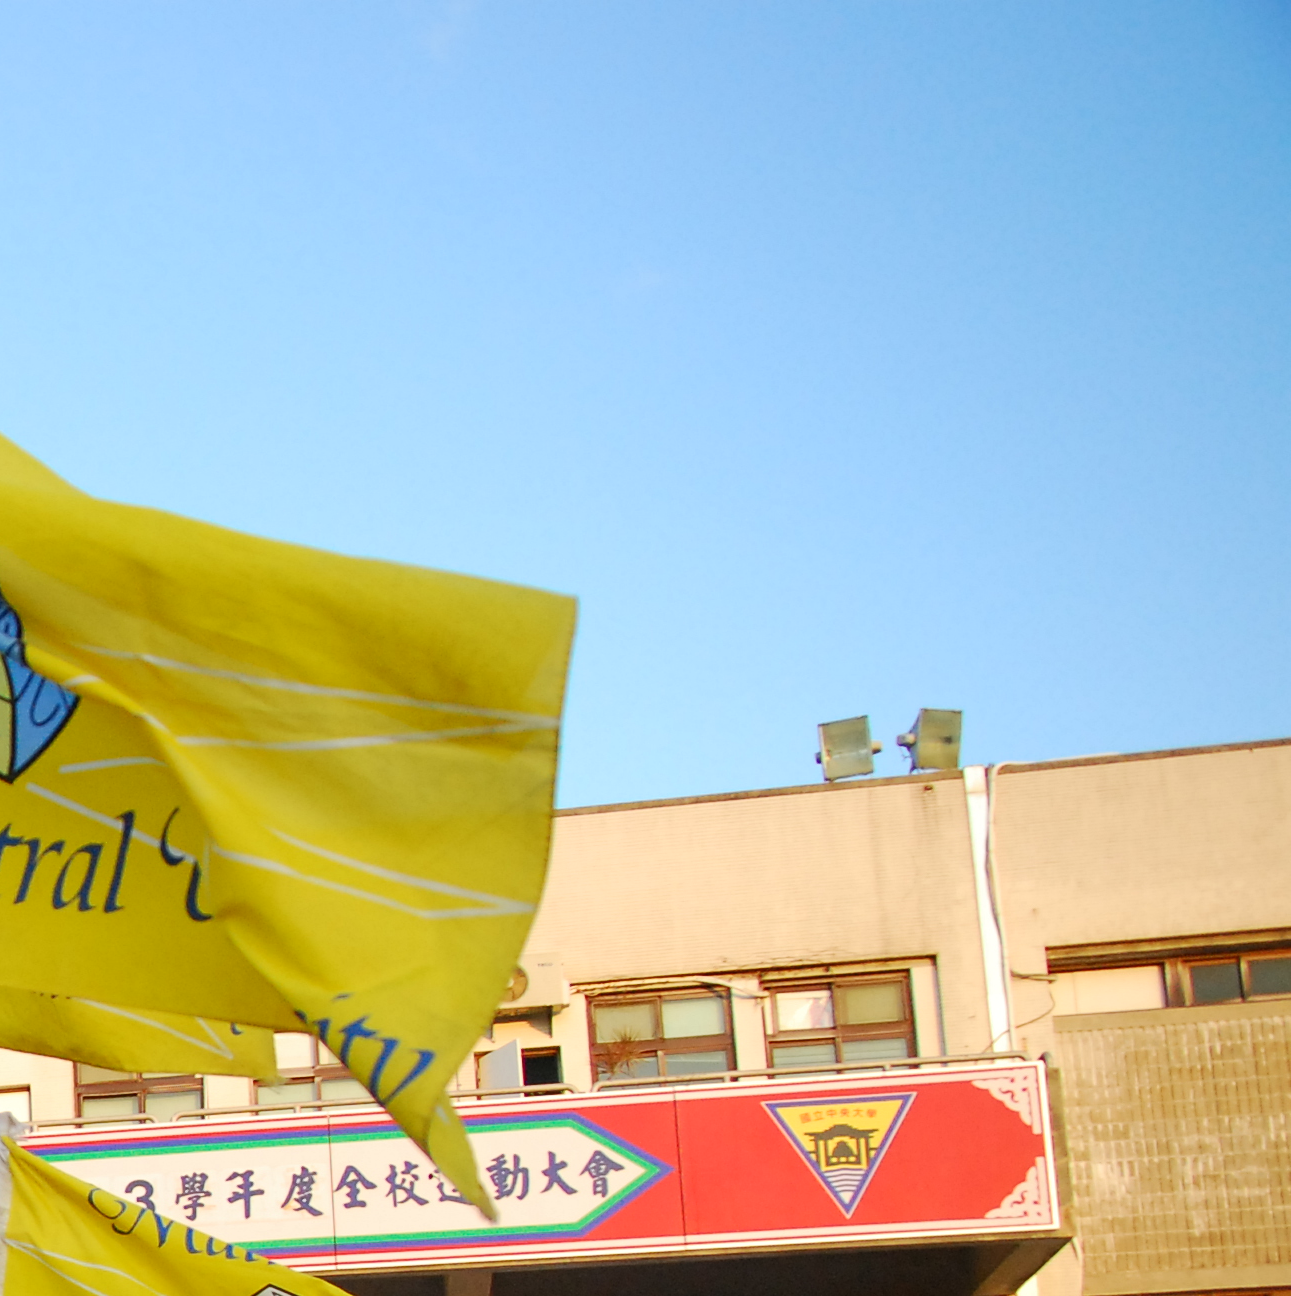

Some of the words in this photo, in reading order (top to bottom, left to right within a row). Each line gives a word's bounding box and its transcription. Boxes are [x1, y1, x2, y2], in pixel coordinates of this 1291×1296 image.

[799, 1108, 878, 1124] 國立中央大學
